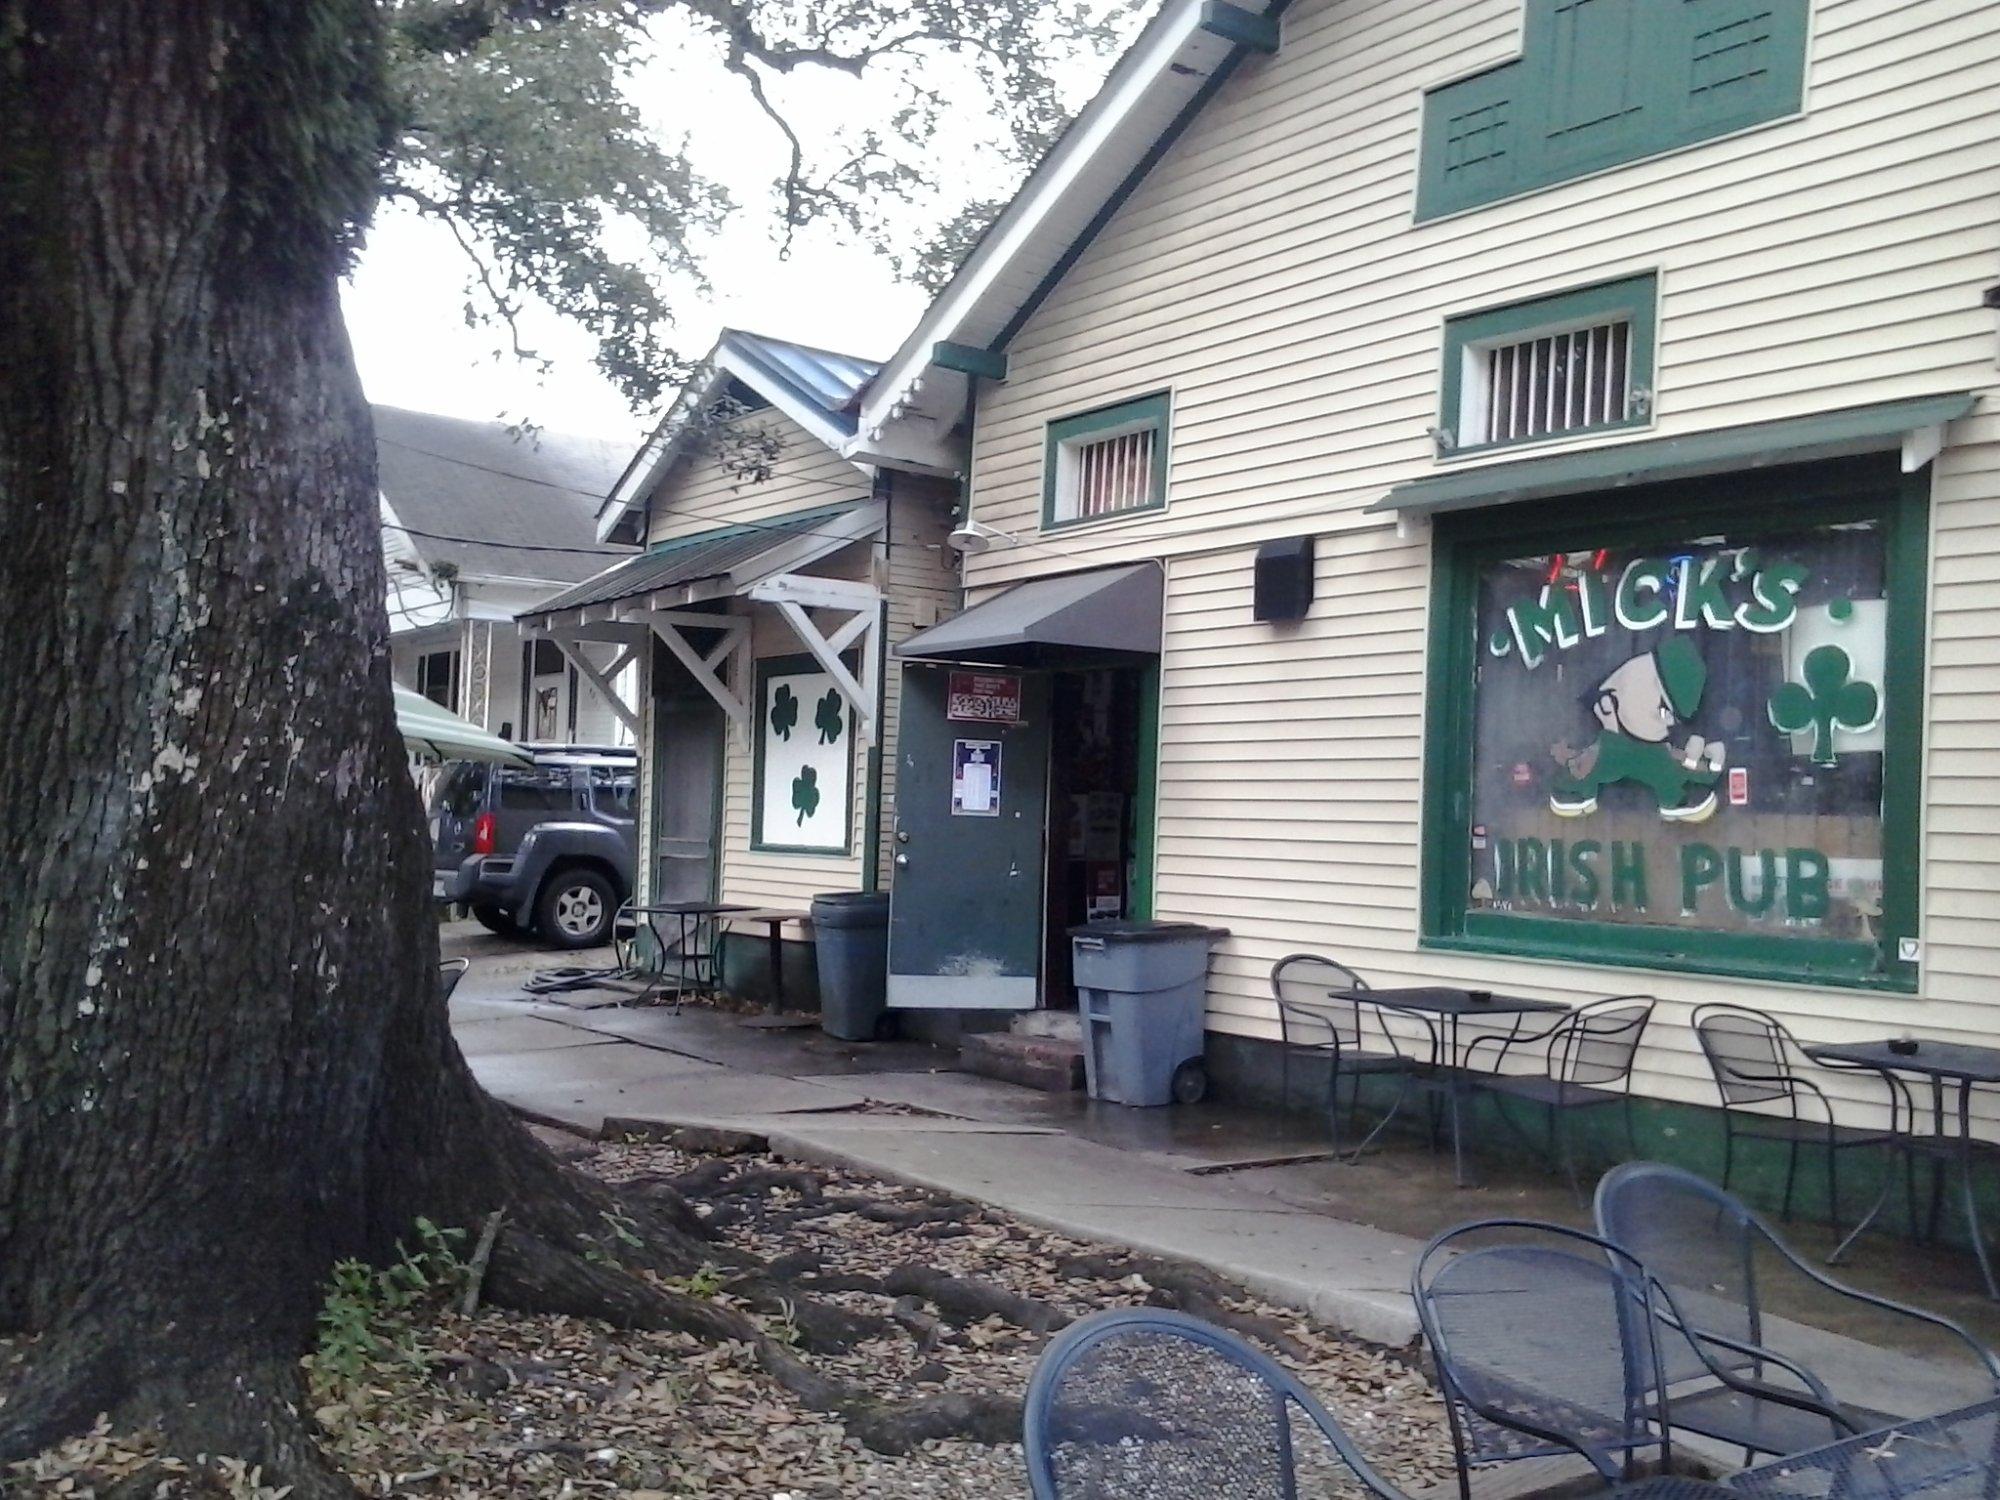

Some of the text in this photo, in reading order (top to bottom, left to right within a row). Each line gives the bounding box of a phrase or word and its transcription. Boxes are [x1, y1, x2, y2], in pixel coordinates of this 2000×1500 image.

[1507, 548, 1809, 670] MICK'S
[1495, 837, 1829, 923] IRISH PUB
